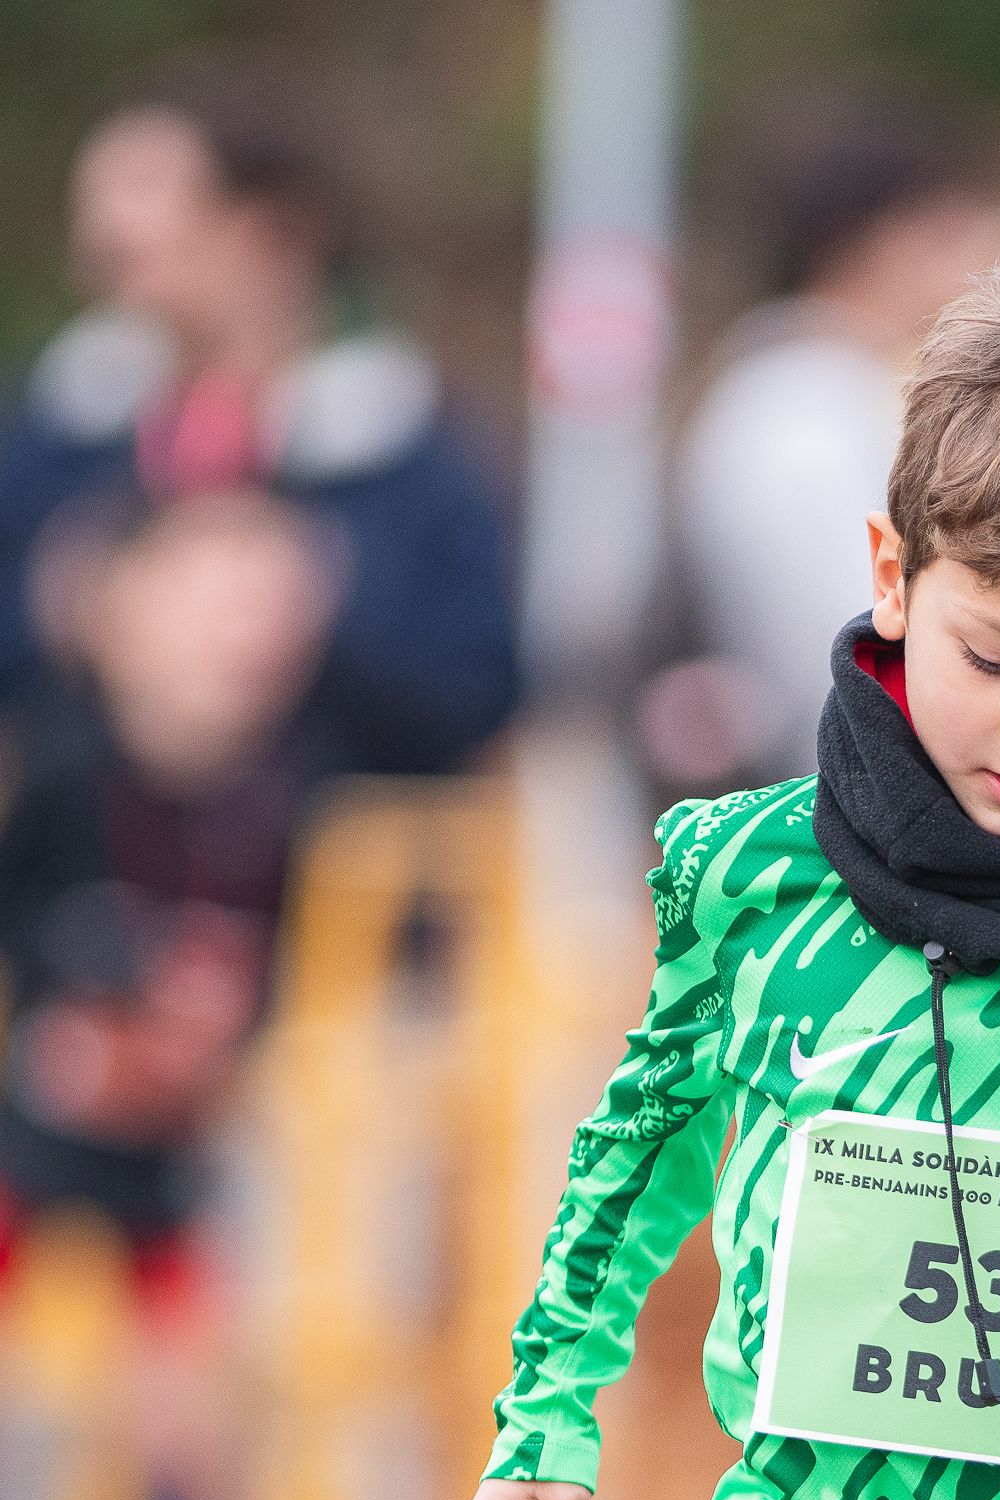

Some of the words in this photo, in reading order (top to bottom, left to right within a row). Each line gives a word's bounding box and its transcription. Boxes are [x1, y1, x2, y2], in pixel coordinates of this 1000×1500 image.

[813, 1137, 835, 1156] IX
[840, 1140, 904, 1166] MILLA
[813, 1169, 949, 1200] PRE-BENJAMINS
